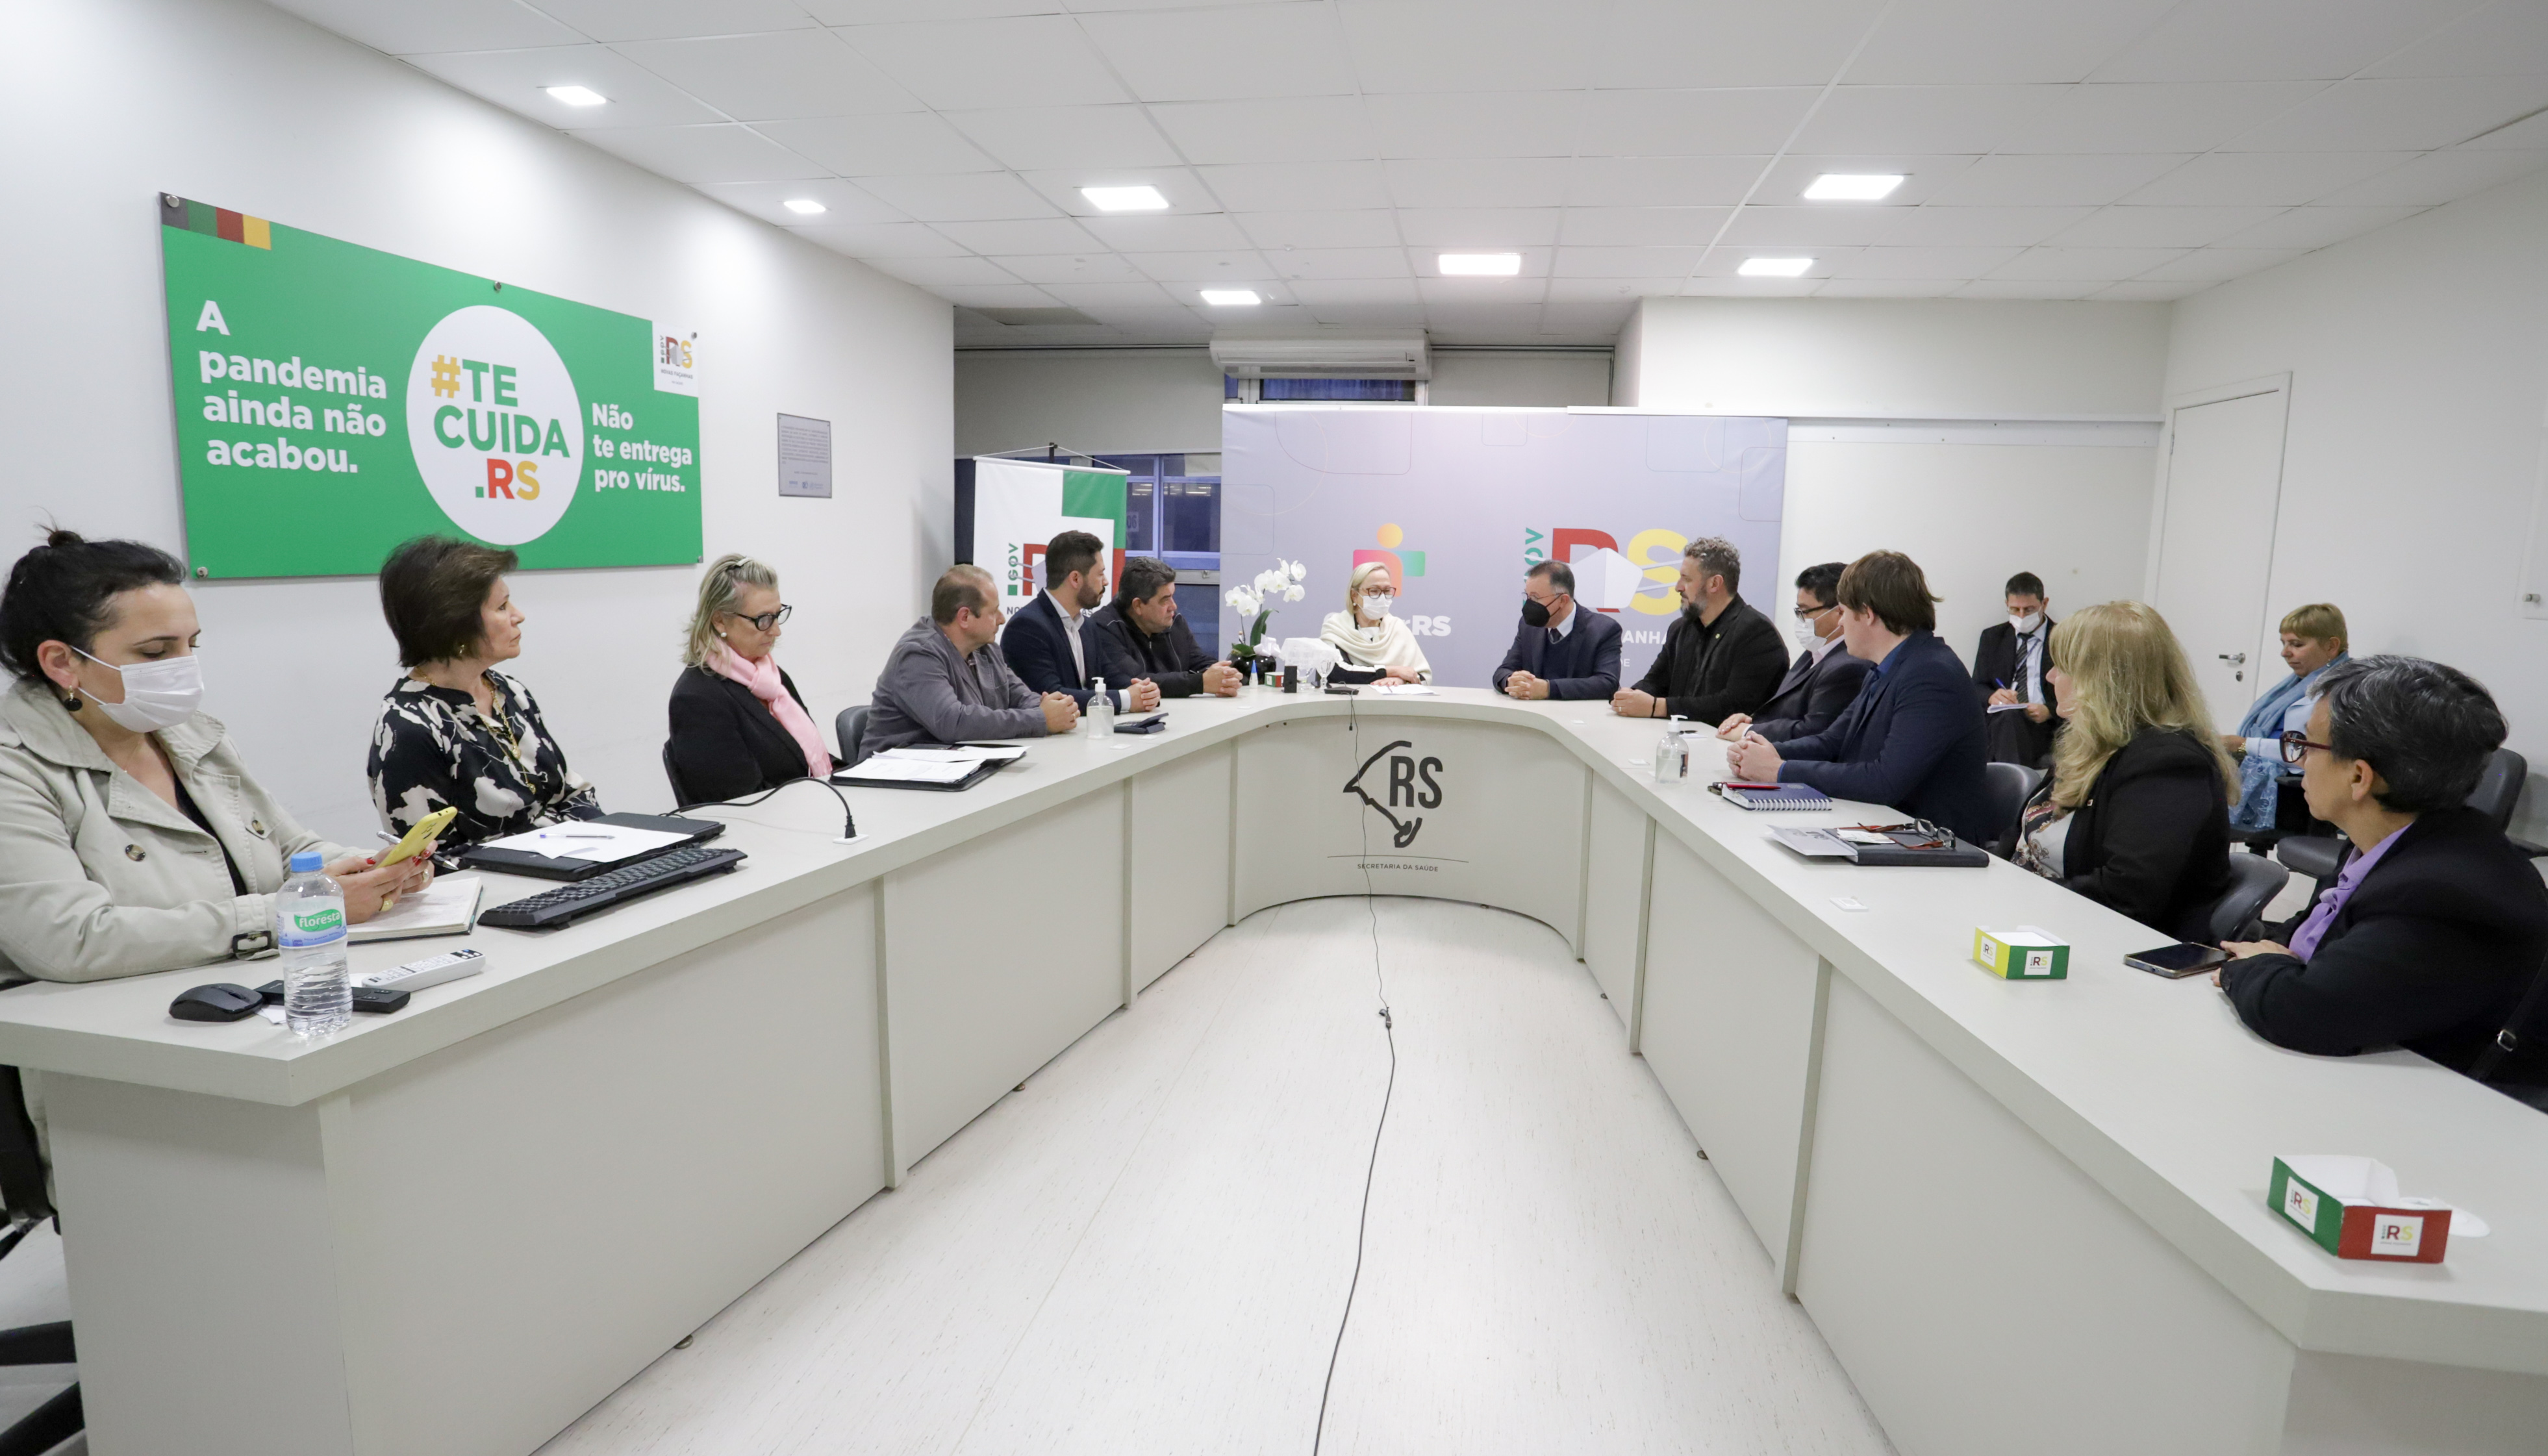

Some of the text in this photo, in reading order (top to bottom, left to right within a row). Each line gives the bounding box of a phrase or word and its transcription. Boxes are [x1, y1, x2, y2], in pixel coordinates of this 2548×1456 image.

[196, 299, 231, 336] A
[199, 351, 387, 399] pandemia
[431, 355, 518, 408] #TE
[203, 390, 387, 437] ainda não
[434, 405, 571, 458] CUIDA
[592, 403, 634, 431] Não
[207, 436, 359, 473] acabou.
[592, 434, 692, 468] te entrega
[475, 458, 540, 501] .RS
[594, 467, 686, 492] pro vírus.
[1389, 755, 1443, 809] RS
[299, 912, 340, 927] floresta
[2033, 956, 2048, 966] RS
[2293, 1190, 2311, 1214] RS
[2386, 1225, 2414, 1242] RS
